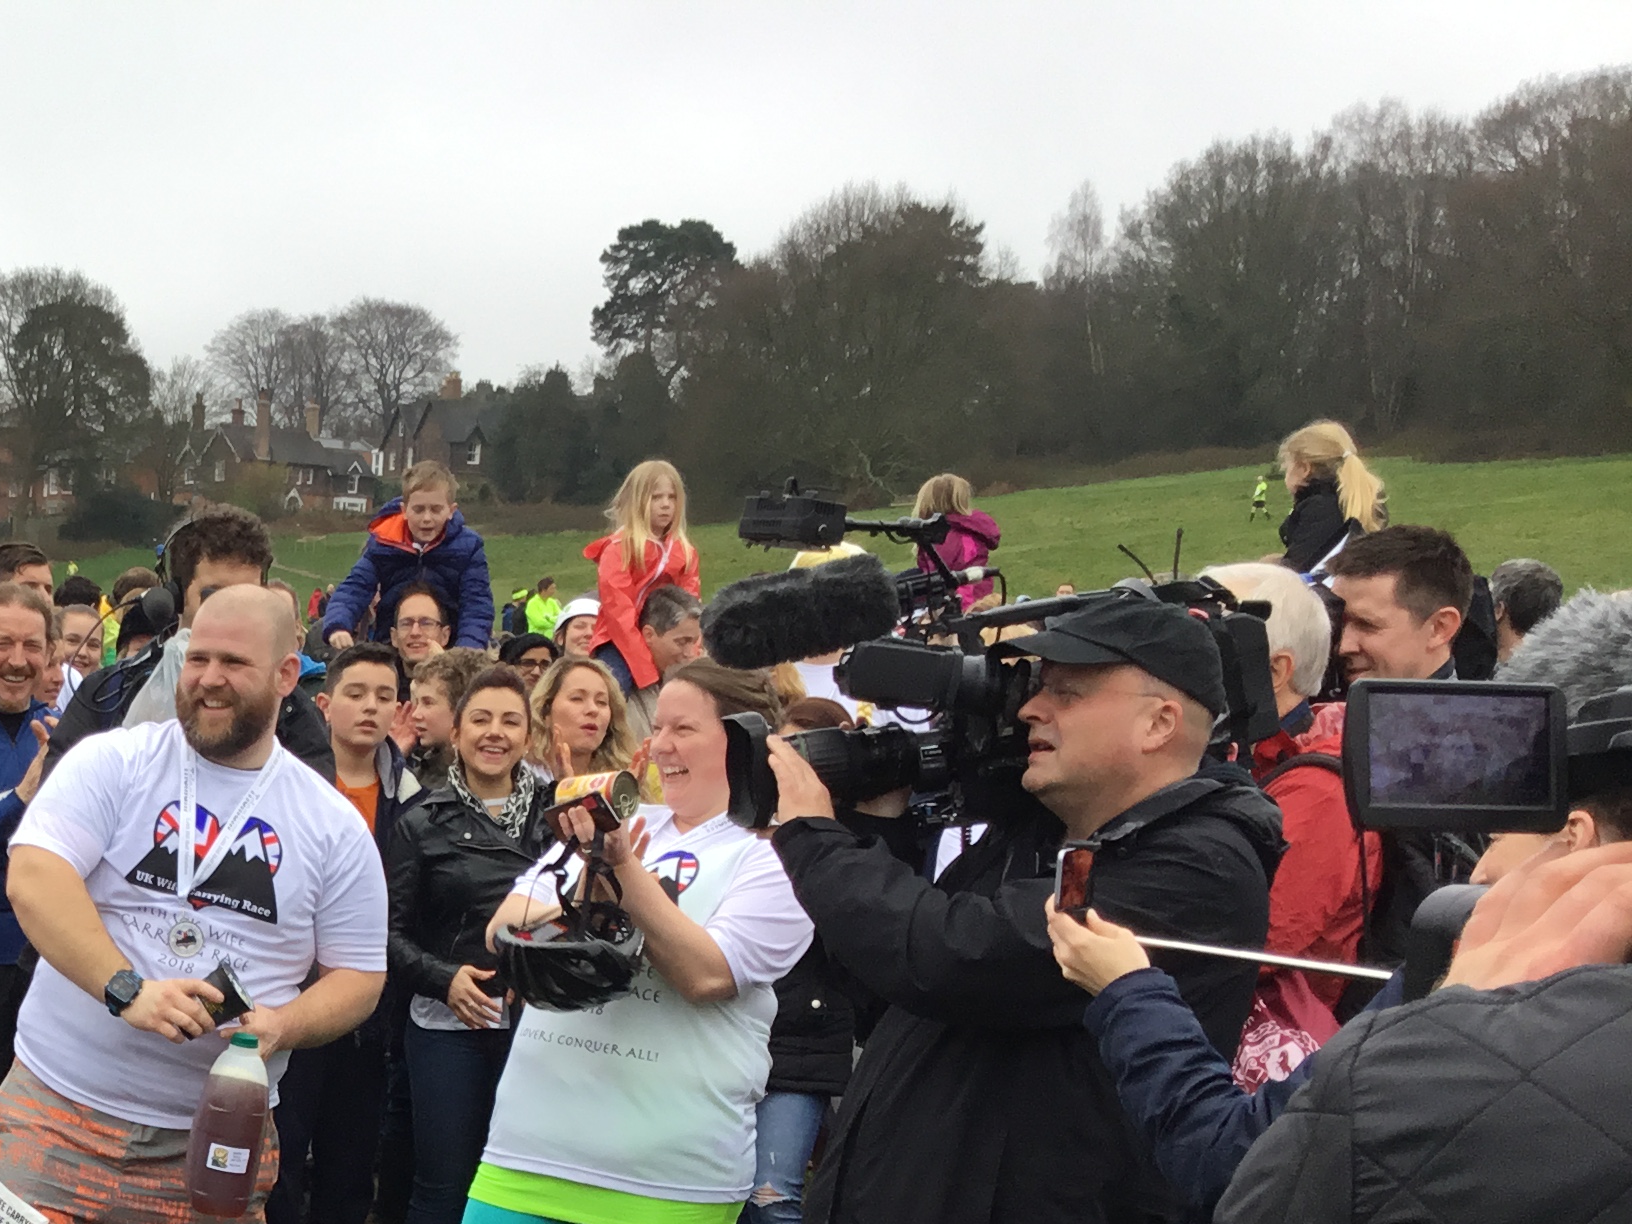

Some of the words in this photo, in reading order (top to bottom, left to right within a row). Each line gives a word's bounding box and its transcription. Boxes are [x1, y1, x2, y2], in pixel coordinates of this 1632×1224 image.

[136, 869, 154, 885] UK
[157, 876, 179, 891] Wif
[242, 899, 271, 918] Race
[209, 924, 246, 950] WIFE
[157, 952, 195, 975] 2018
[628, 985, 663, 1004] ACE
[557, 1034, 621, 1057] CONQUER
[625, 1047, 660, 1063] ALL!
